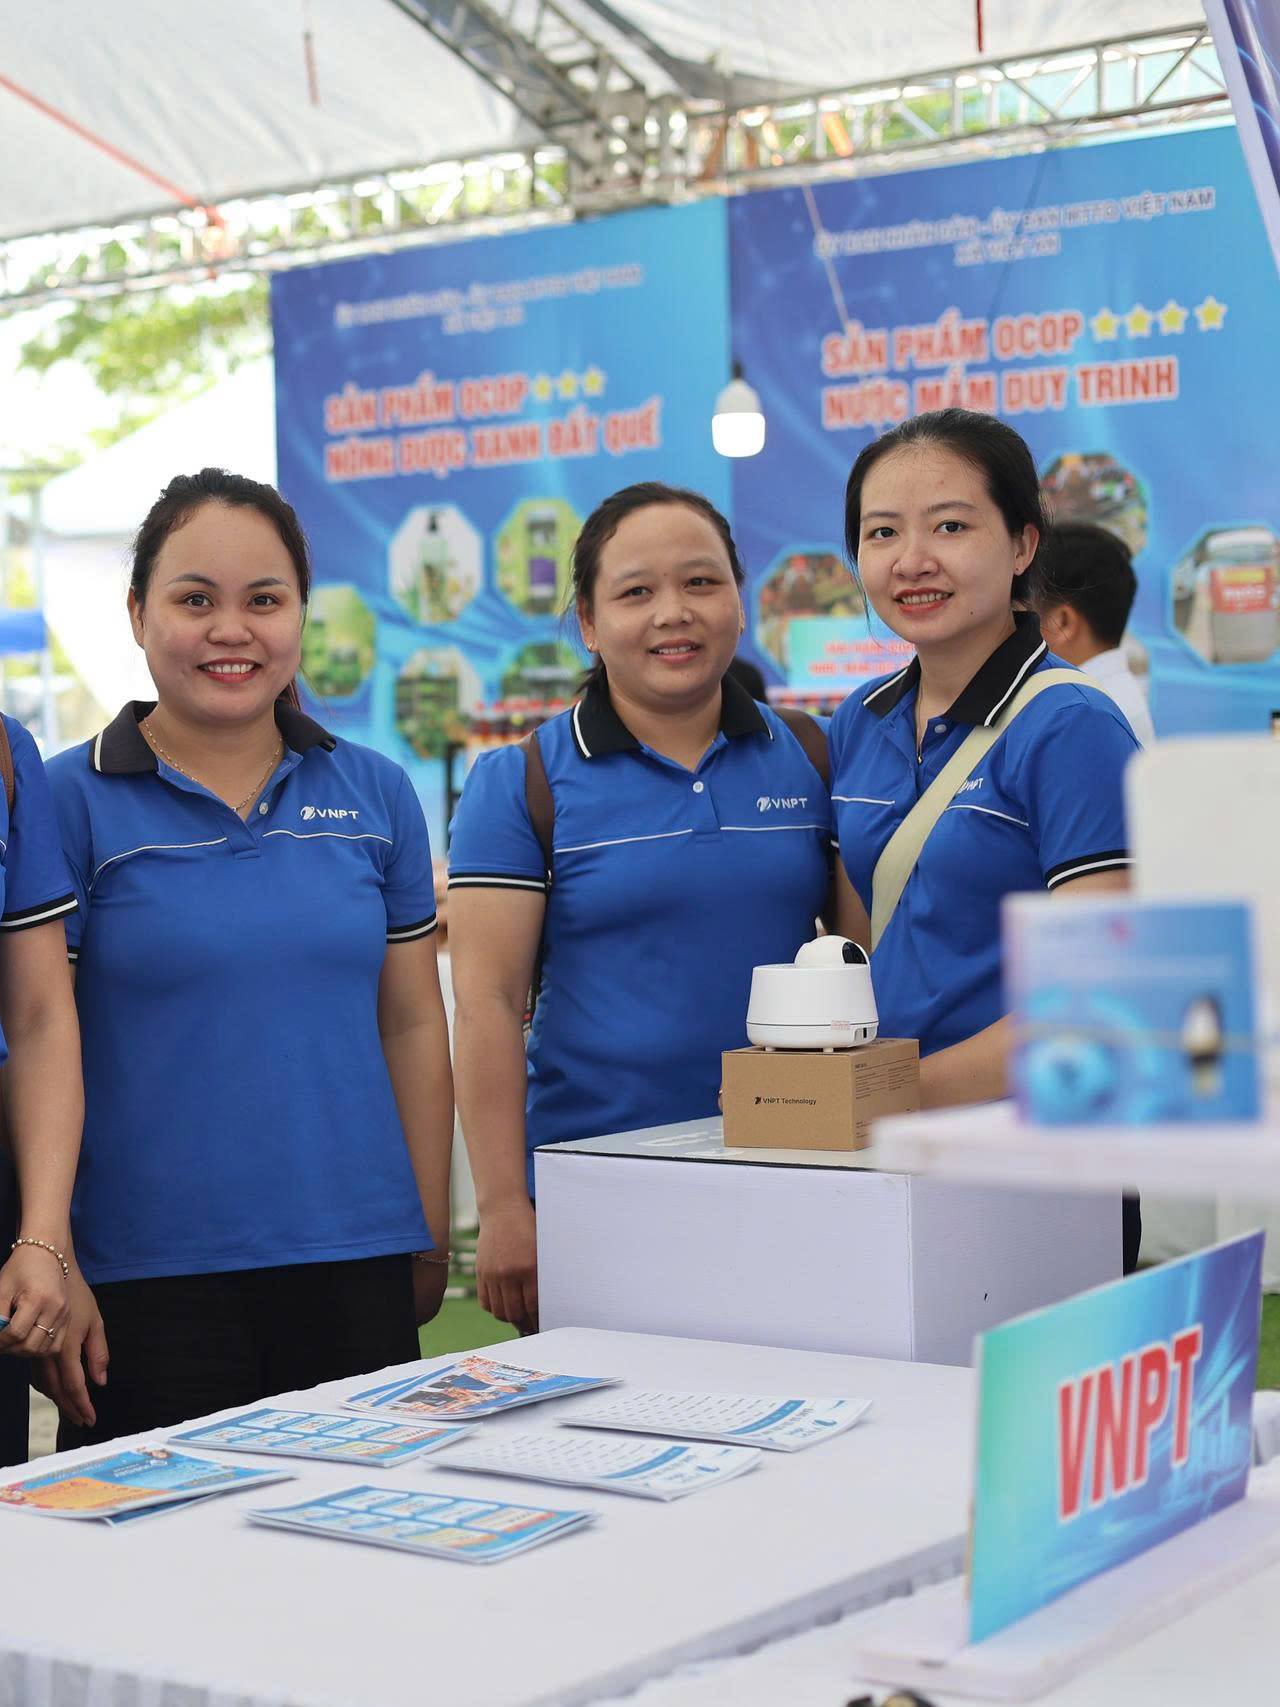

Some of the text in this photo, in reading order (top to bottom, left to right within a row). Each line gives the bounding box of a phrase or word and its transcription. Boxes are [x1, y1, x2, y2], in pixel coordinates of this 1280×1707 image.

[1169, 187, 1214, 214] NAM
[823, 307, 1082, 376] SẢN PHẨM OCOP
[325, 370, 527, 434] SẢN PHẨM OCOP
[1003, 366, 1066, 414] DUY
[1076, 355, 1178, 407] TRINH
[473, 422, 541, 468] XANH
[316, 808, 359, 820] VNPT
[771, 797, 808, 809] VNPT
[781, 1097, 817, 1106] Technology
[1057, 1325, 1203, 1524] VNPT
